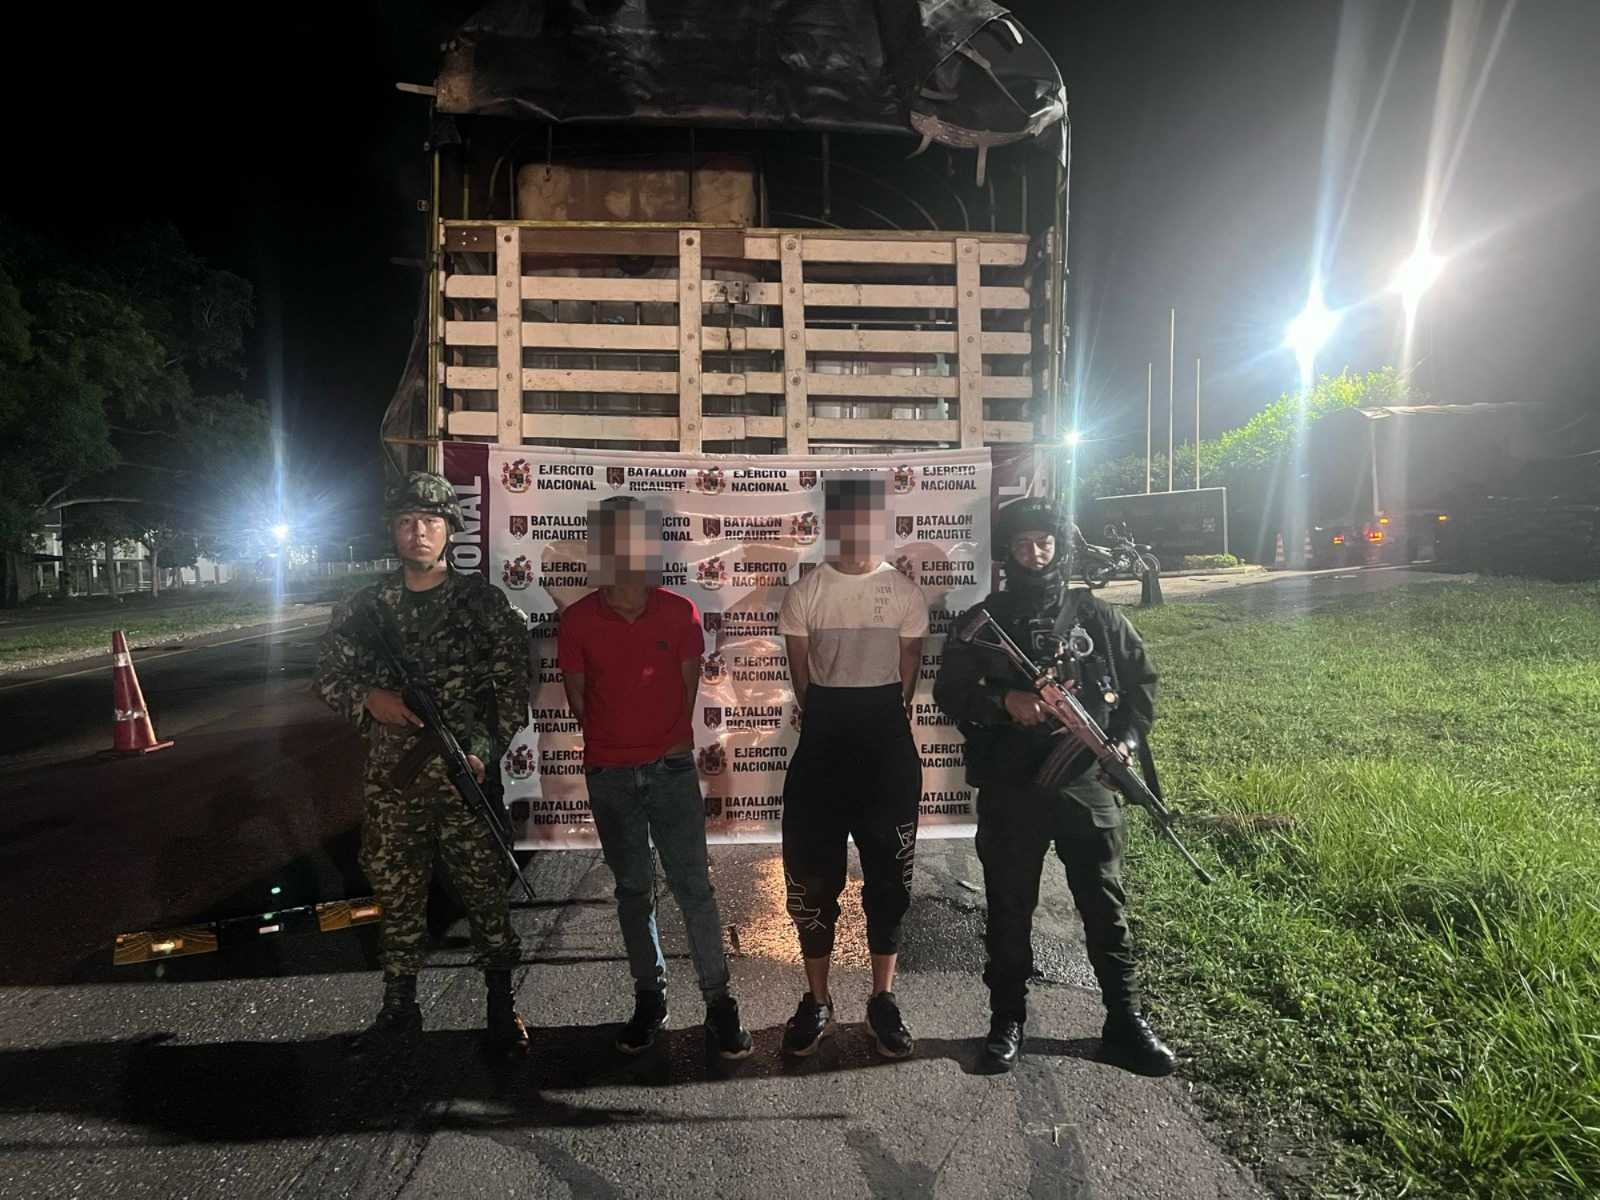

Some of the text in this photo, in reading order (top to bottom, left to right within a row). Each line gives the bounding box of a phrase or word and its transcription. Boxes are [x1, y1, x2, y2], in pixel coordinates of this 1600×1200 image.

[539, 465, 594, 476] EJERCITO
[627, 467, 687, 478] BATALLON
[733, 470, 787, 478] EJERCITO
[923, 466, 976, 476] EJERCITO
[537, 479, 597, 490] NACIONAL
[629, 481, 685, 492] RICAURTE
[731, 482, 789, 492] NACIONAL
[921, 480, 977, 490] NACIONAL
[662, 517, 690, 527] CITO
[723, 517, 782, 528] BATALLON
[916, 515, 972, 526] BATALLON
[532, 530, 588, 540] RICAURTE
[662, 531, 693, 541] ONAL
[725, 530, 780, 540] RICAURTE
[917, 529, 972, 540] RICAURTE
[541, 562, 587, 573] EJERCIT
[734, 563, 787, 573] EJERCITO
[921, 561, 975, 571] EJERCITO
[539, 576, 588, 587] NACIONA
[732, 576, 790, 587] NACIONAL
[920, 575, 977, 586] NACIONAL
[530, 612, 560, 623] BATA
[531, 628, 558, 638] RICA
[734, 656, 787, 667] EJERCITO
[732, 671, 789, 681] NACIONAL
[532, 709, 576, 719] BATALL
[724, 706, 782, 717] BATALLON
[533, 722, 582, 733] RICAURT
[726, 719, 781, 730] RICAURTE
[734, 747, 787, 758] EJERCITO
[921, 744, 965, 754] EJERCIT
[542, 750, 584, 760] EJERCI
[732, 761, 788, 772] NACIONAL
[920, 758, 966, 767] NACIONA
[541, 765, 584, 775] NACION
[725, 796, 783, 807] BATALLON
[920, 791, 971, 802] ATALLON
[534, 813, 591, 824] RICAURTE
[726, 810, 781, 820] RICAURTE
